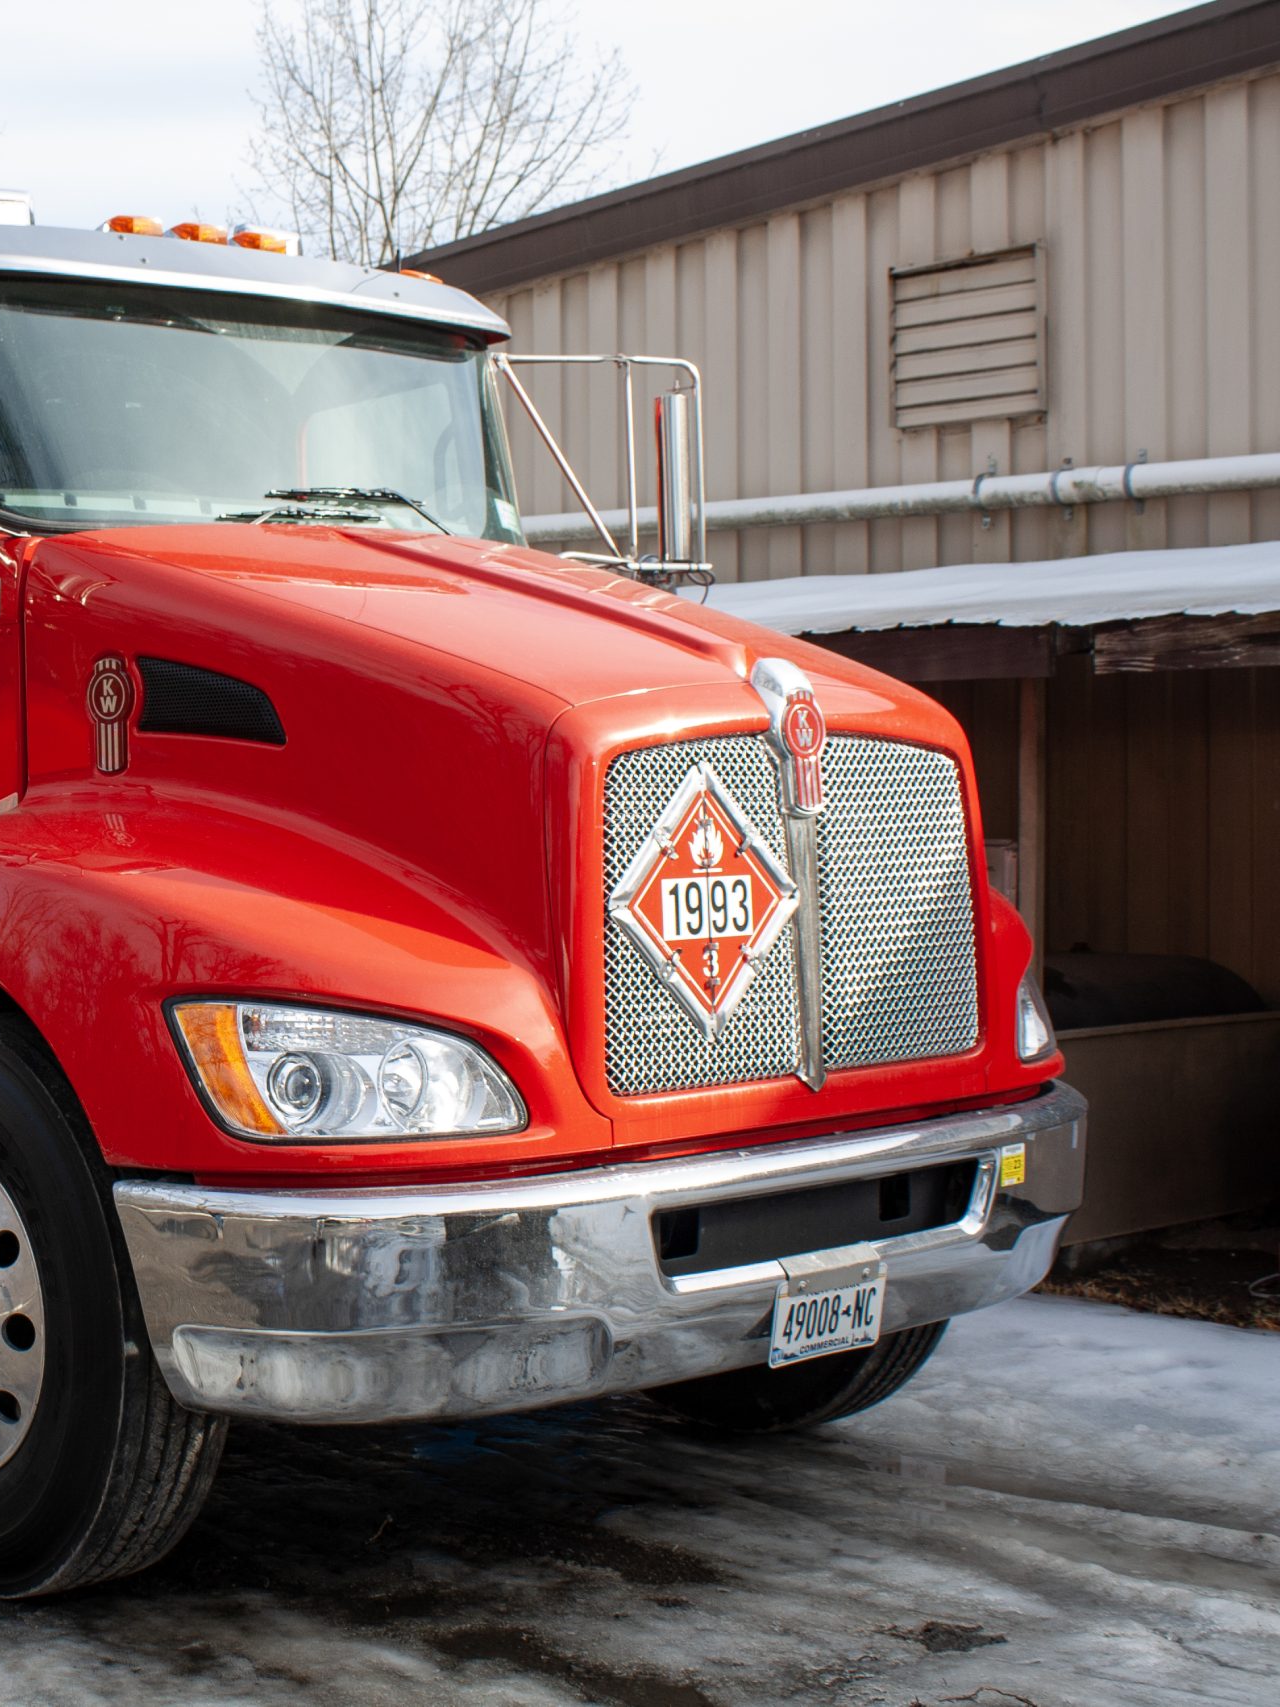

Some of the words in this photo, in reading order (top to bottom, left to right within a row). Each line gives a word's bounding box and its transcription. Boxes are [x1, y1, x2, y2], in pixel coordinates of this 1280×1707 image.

[668, 879, 750, 936] 1993
[702, 949, 720, 978] 3
[800, 1337, 849, 1354] COMMERCIAL
